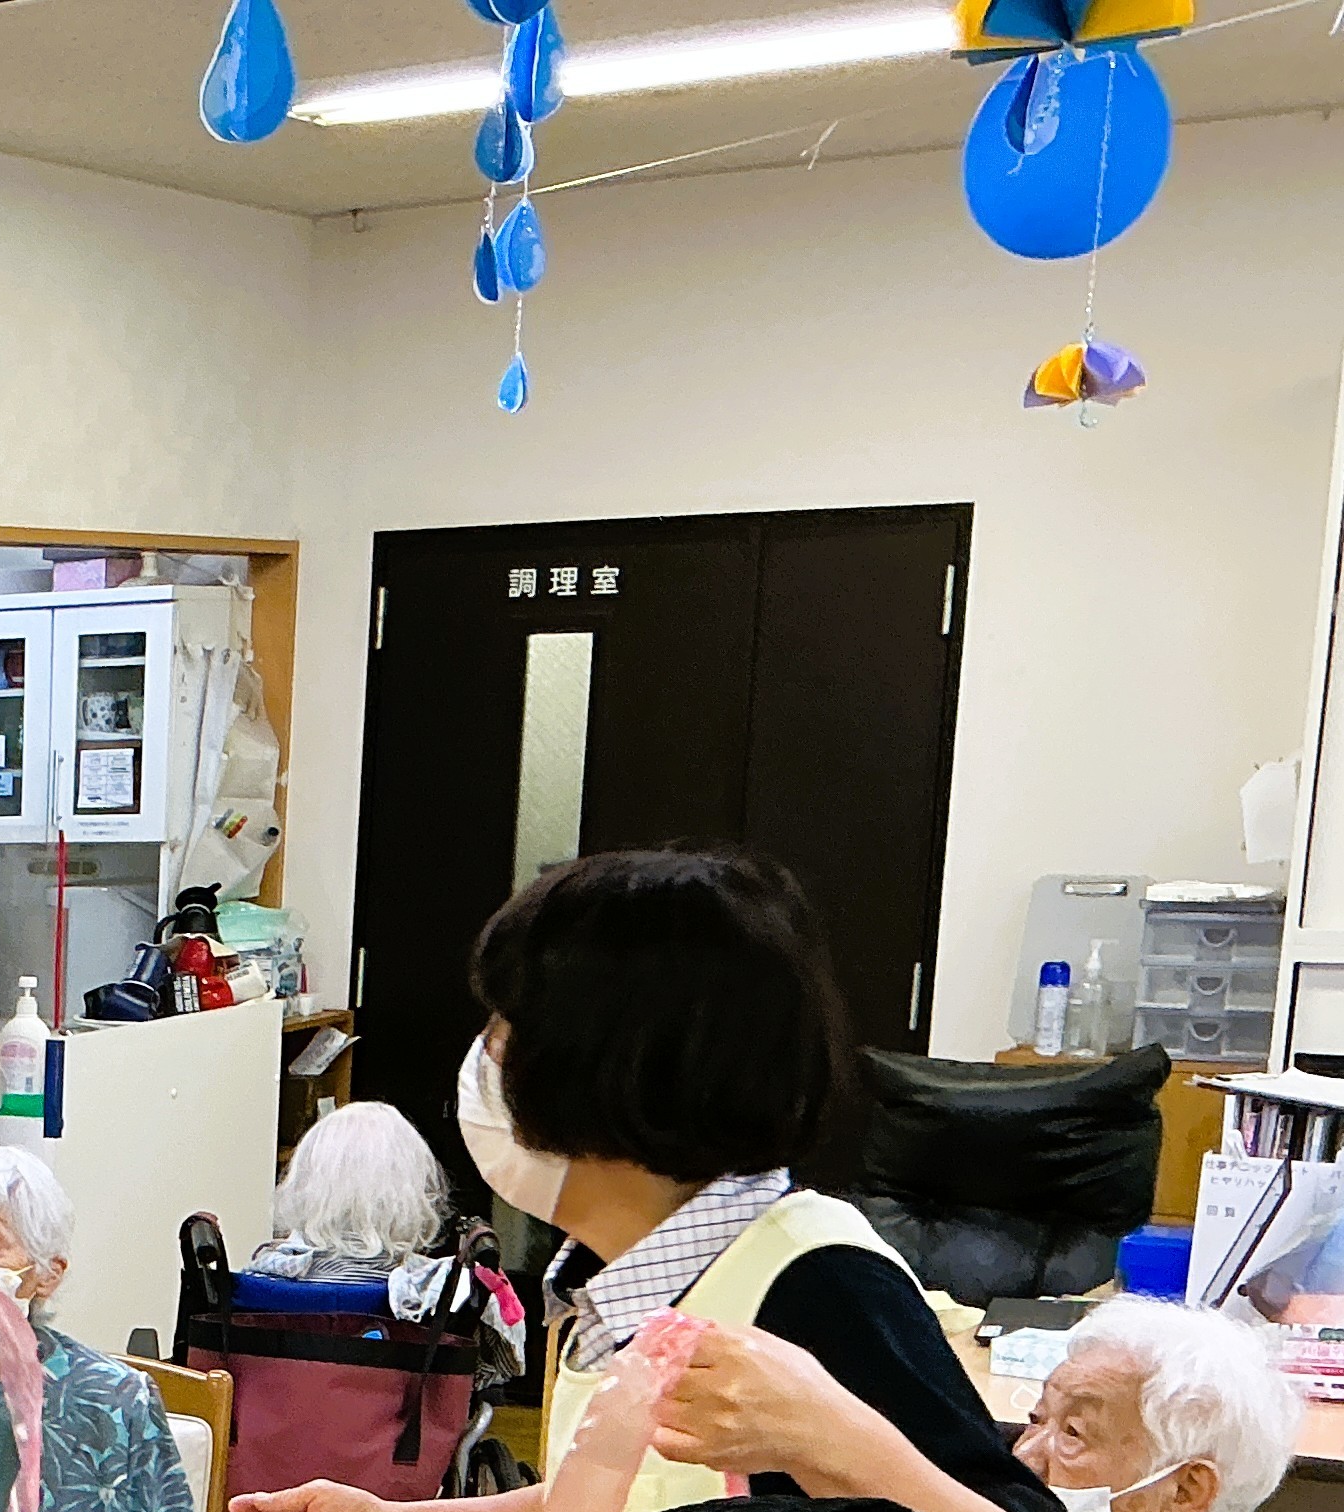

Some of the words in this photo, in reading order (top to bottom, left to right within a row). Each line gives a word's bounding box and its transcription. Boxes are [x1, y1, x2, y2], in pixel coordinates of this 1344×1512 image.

[508, 564, 620, 598] 調理室
[1210, 1175, 1269, 1189] ヒヤリハッ
